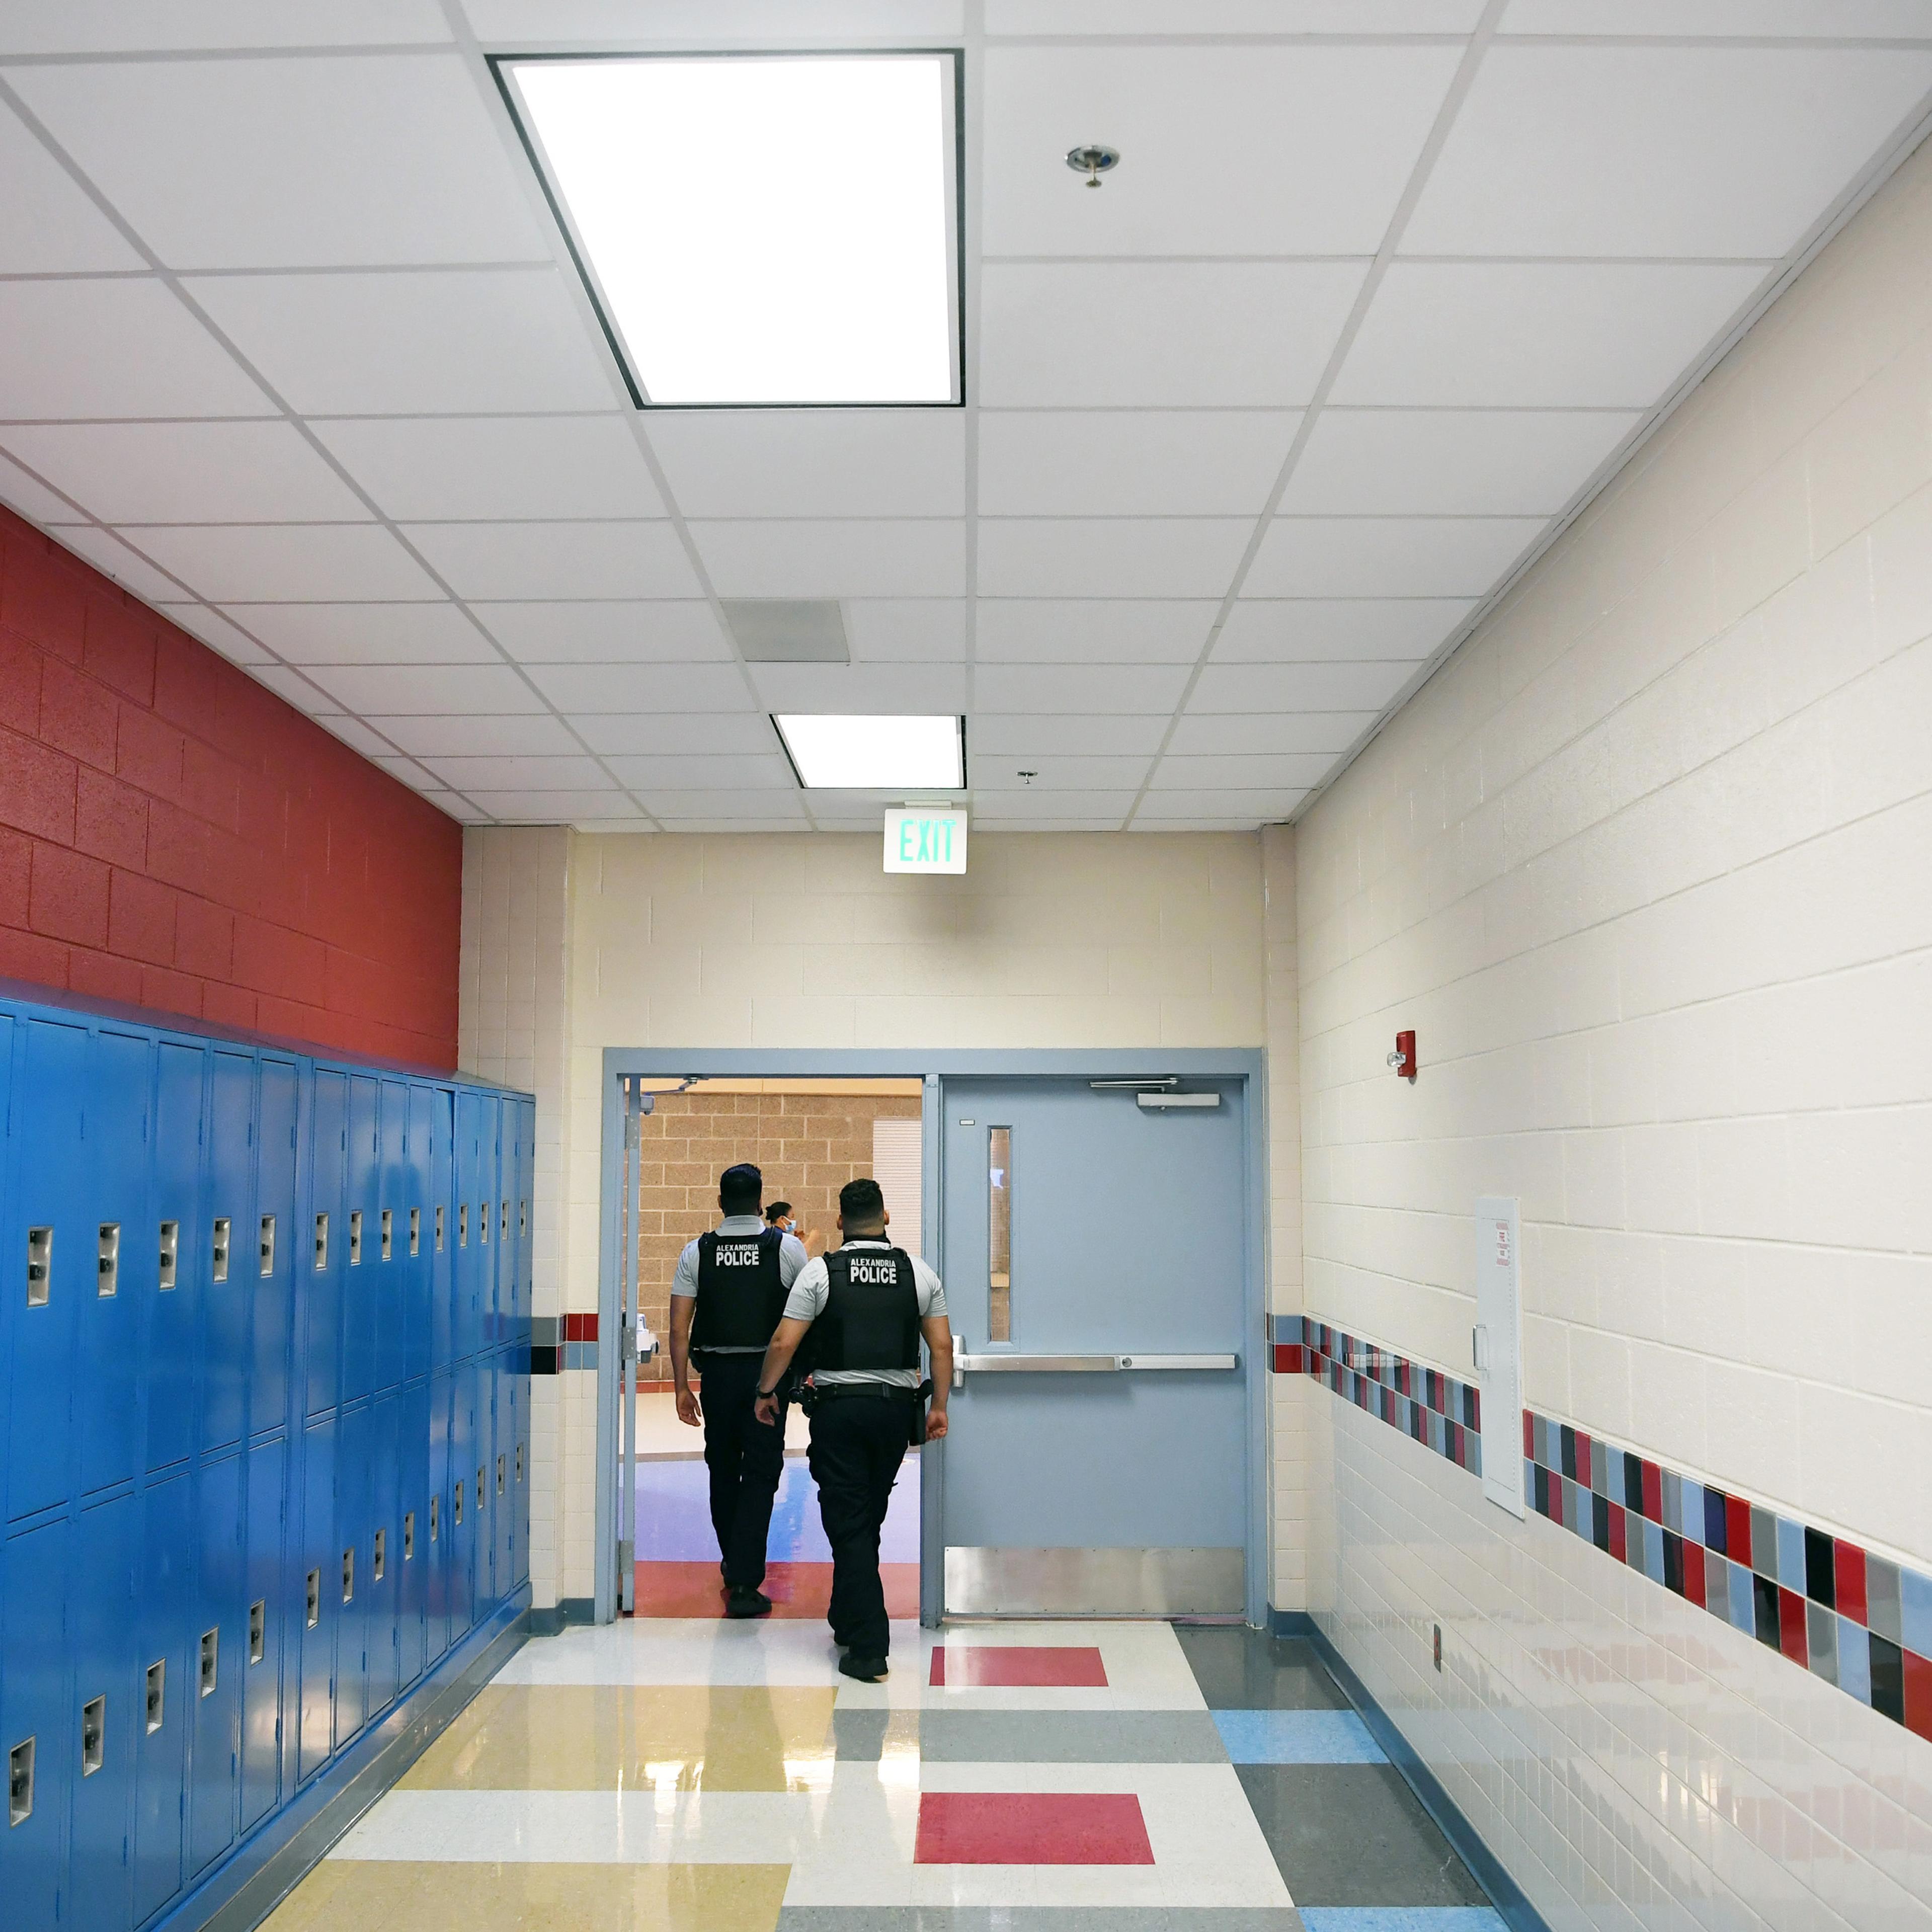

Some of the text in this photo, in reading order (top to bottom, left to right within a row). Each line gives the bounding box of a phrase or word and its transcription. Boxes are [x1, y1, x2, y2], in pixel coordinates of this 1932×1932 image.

[900, 819, 957, 862] EXIT
[716, 1251, 759, 1266] POLICE
[850, 1258, 896, 1267] ALEXANDRIA
[850, 1266, 897, 1284] POLICE
